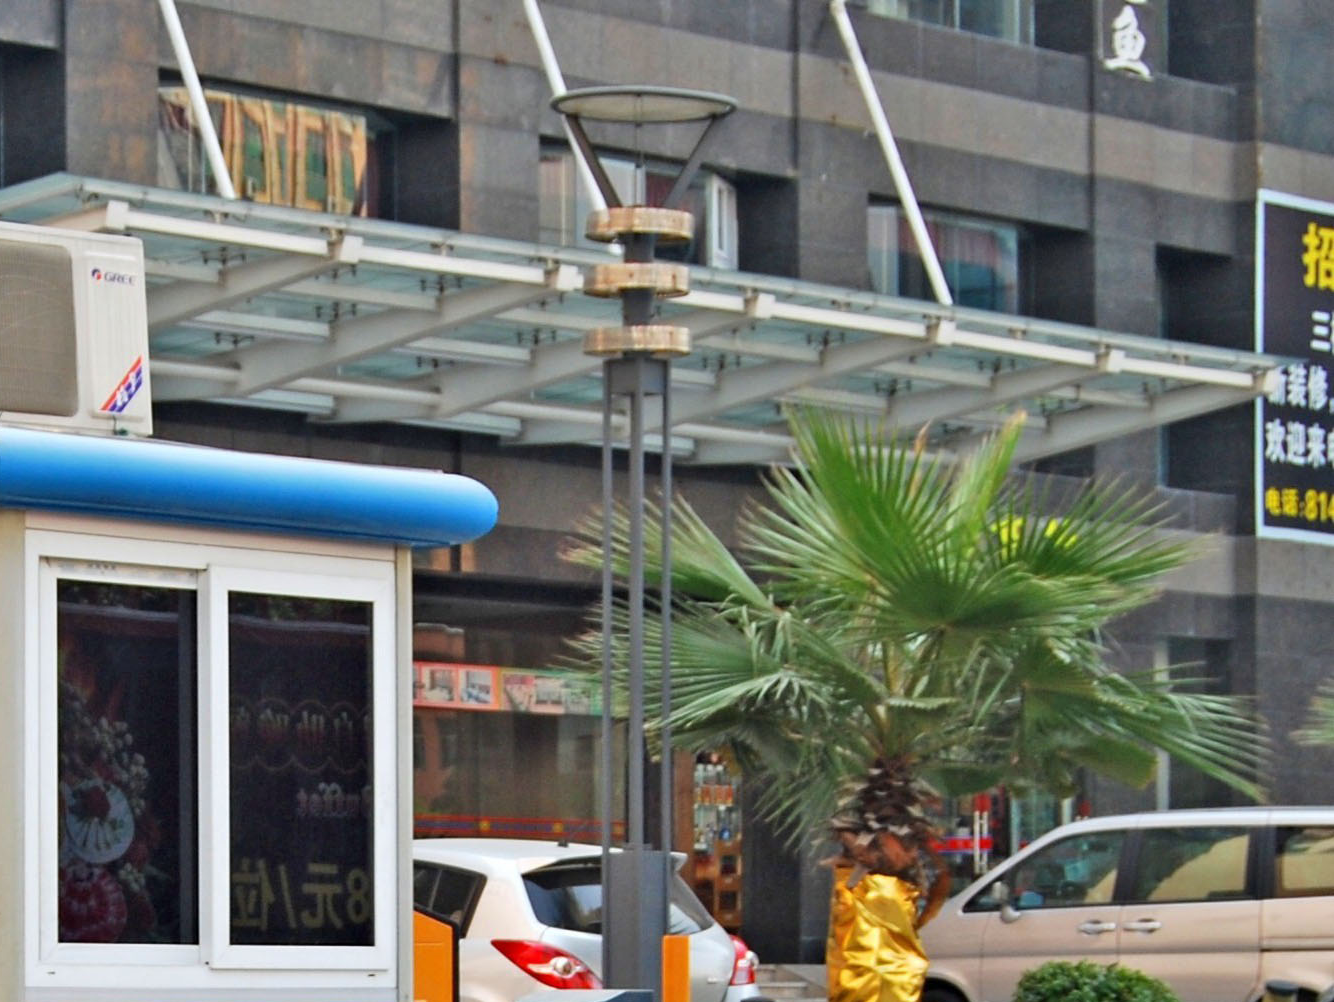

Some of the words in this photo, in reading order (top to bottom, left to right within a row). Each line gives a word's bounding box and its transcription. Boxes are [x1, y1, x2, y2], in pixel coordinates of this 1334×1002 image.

[1104, 0, 1154, 81] 鱼
[104, 271, 137, 286] GREE
[1310, 310, 1334, 352] 三
